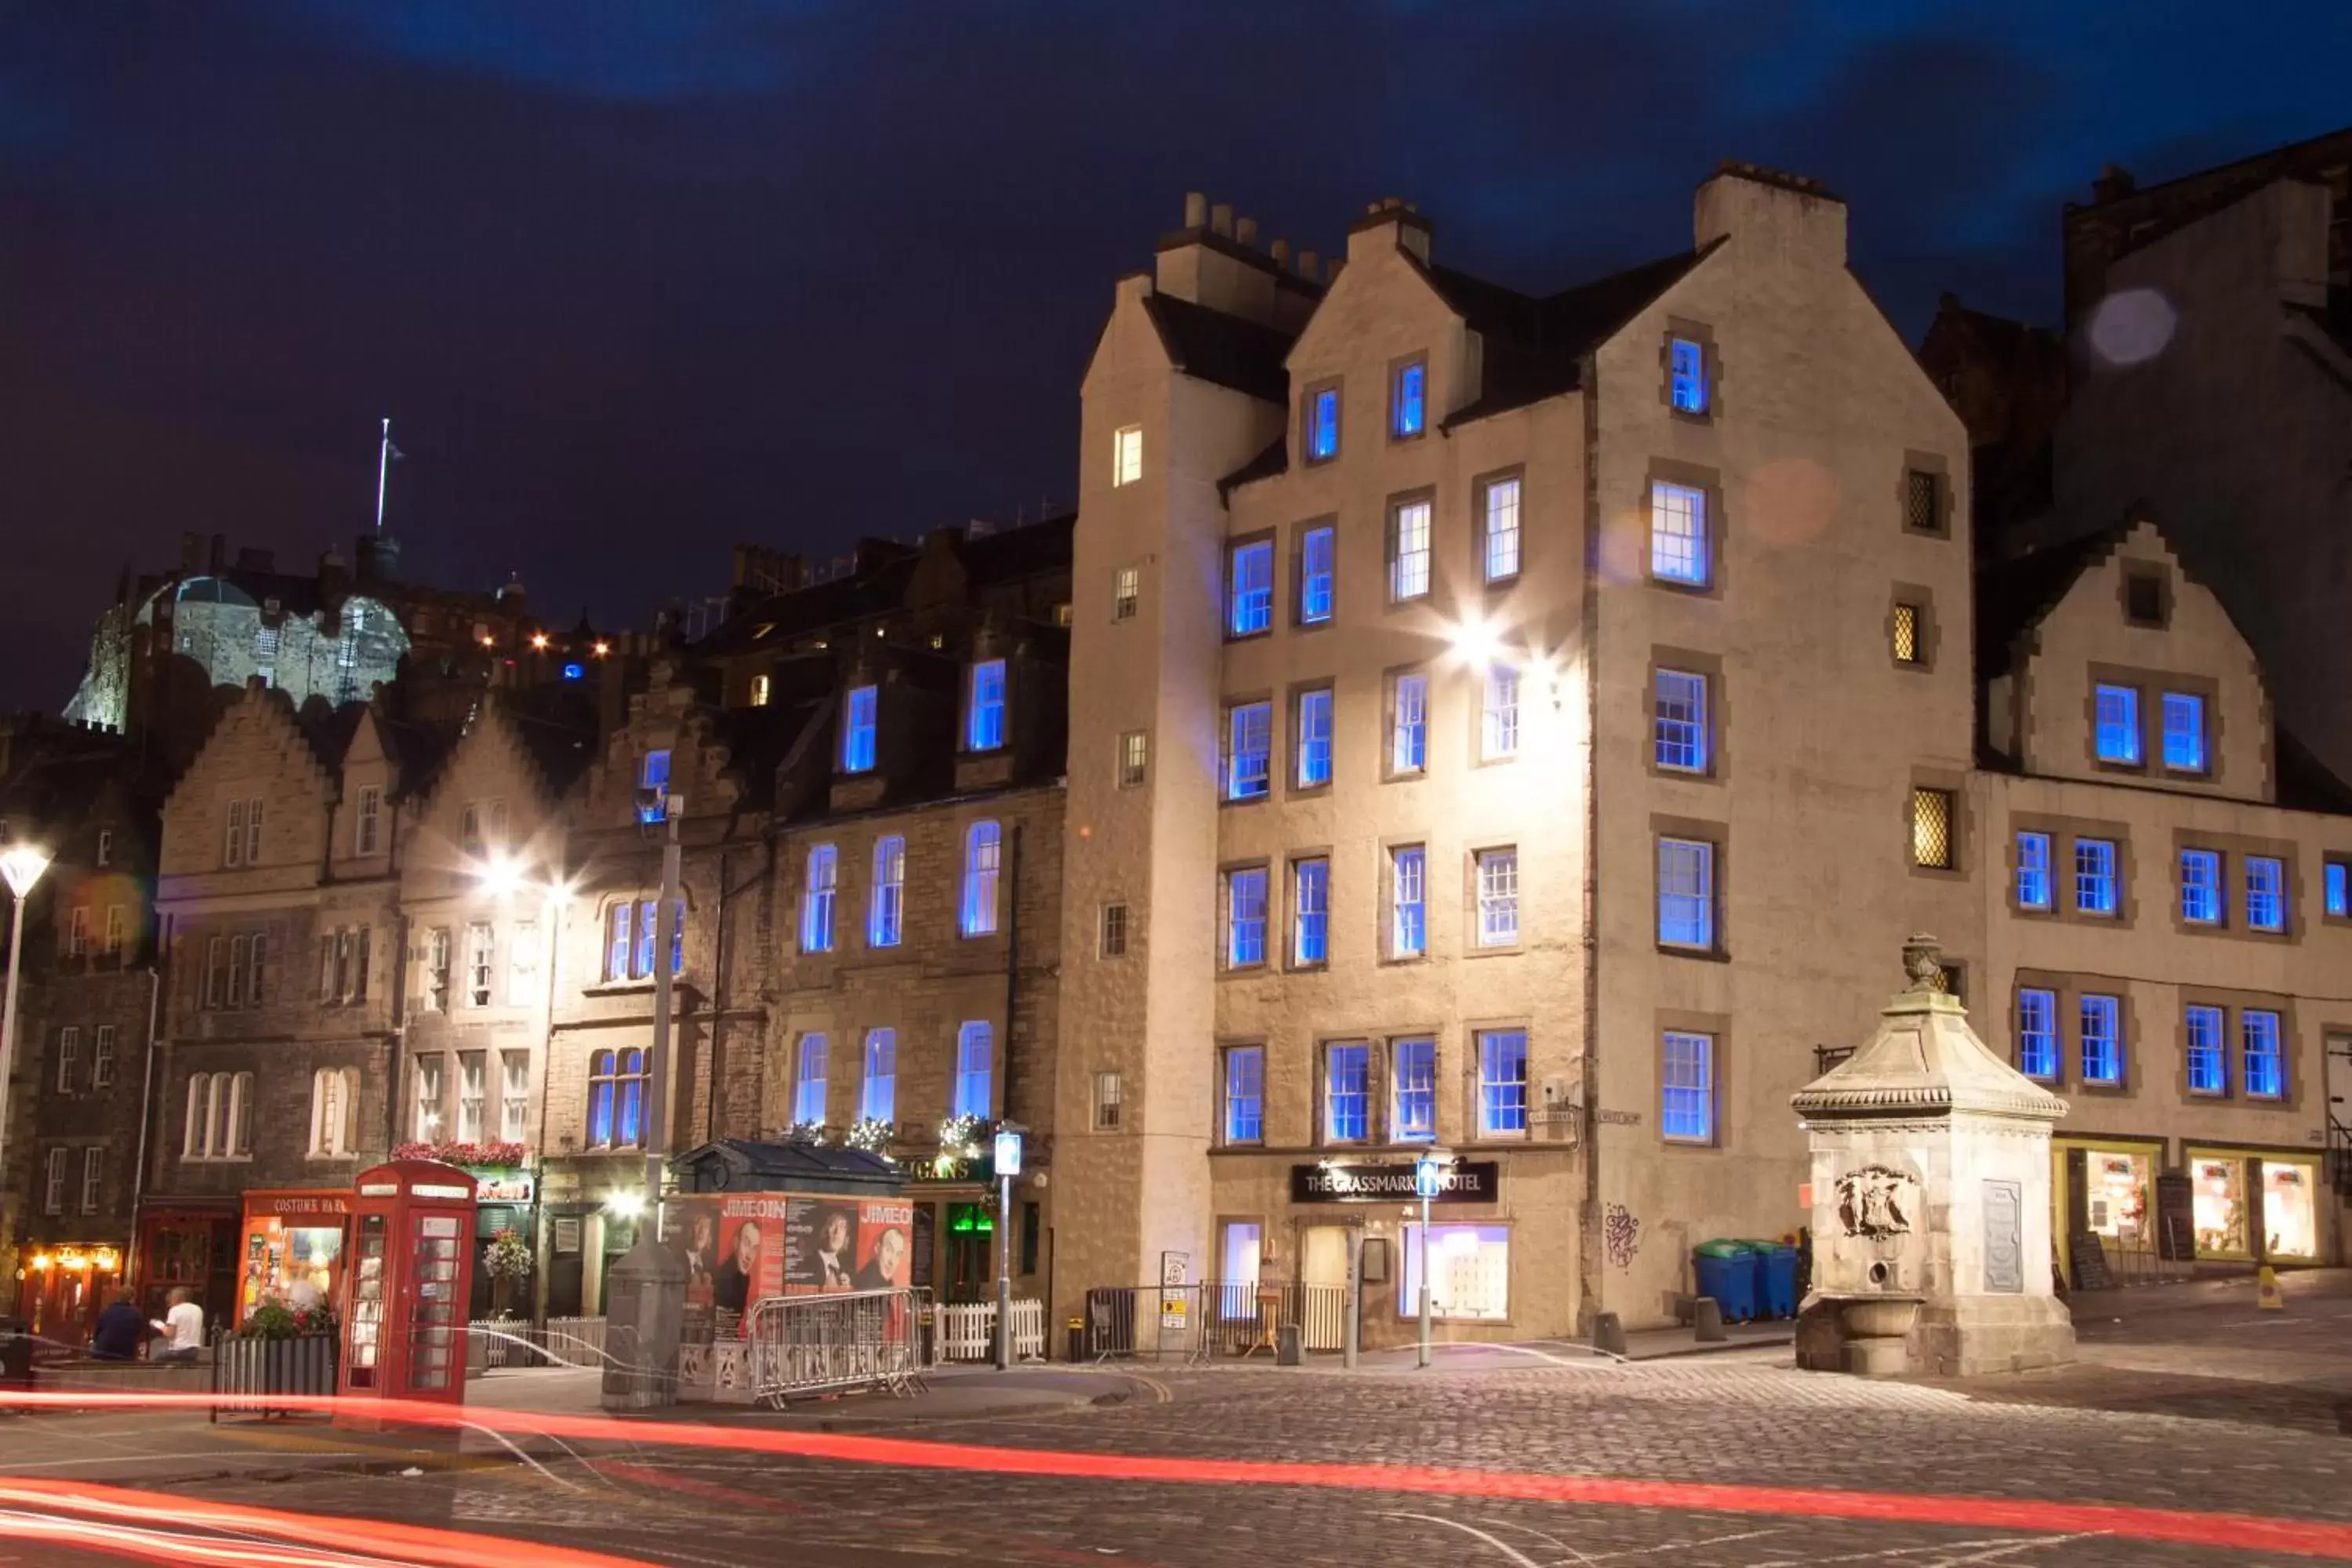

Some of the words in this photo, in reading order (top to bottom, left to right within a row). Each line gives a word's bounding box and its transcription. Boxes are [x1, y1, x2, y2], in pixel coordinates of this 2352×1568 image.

[1305, 1174, 1332, 1192] THE
[1333, 1174, 1417, 1192] GRASSMARK
[275, 1198, 318, 1214] COSTUME
[722, 1200, 786, 1219] JIMEOIN
